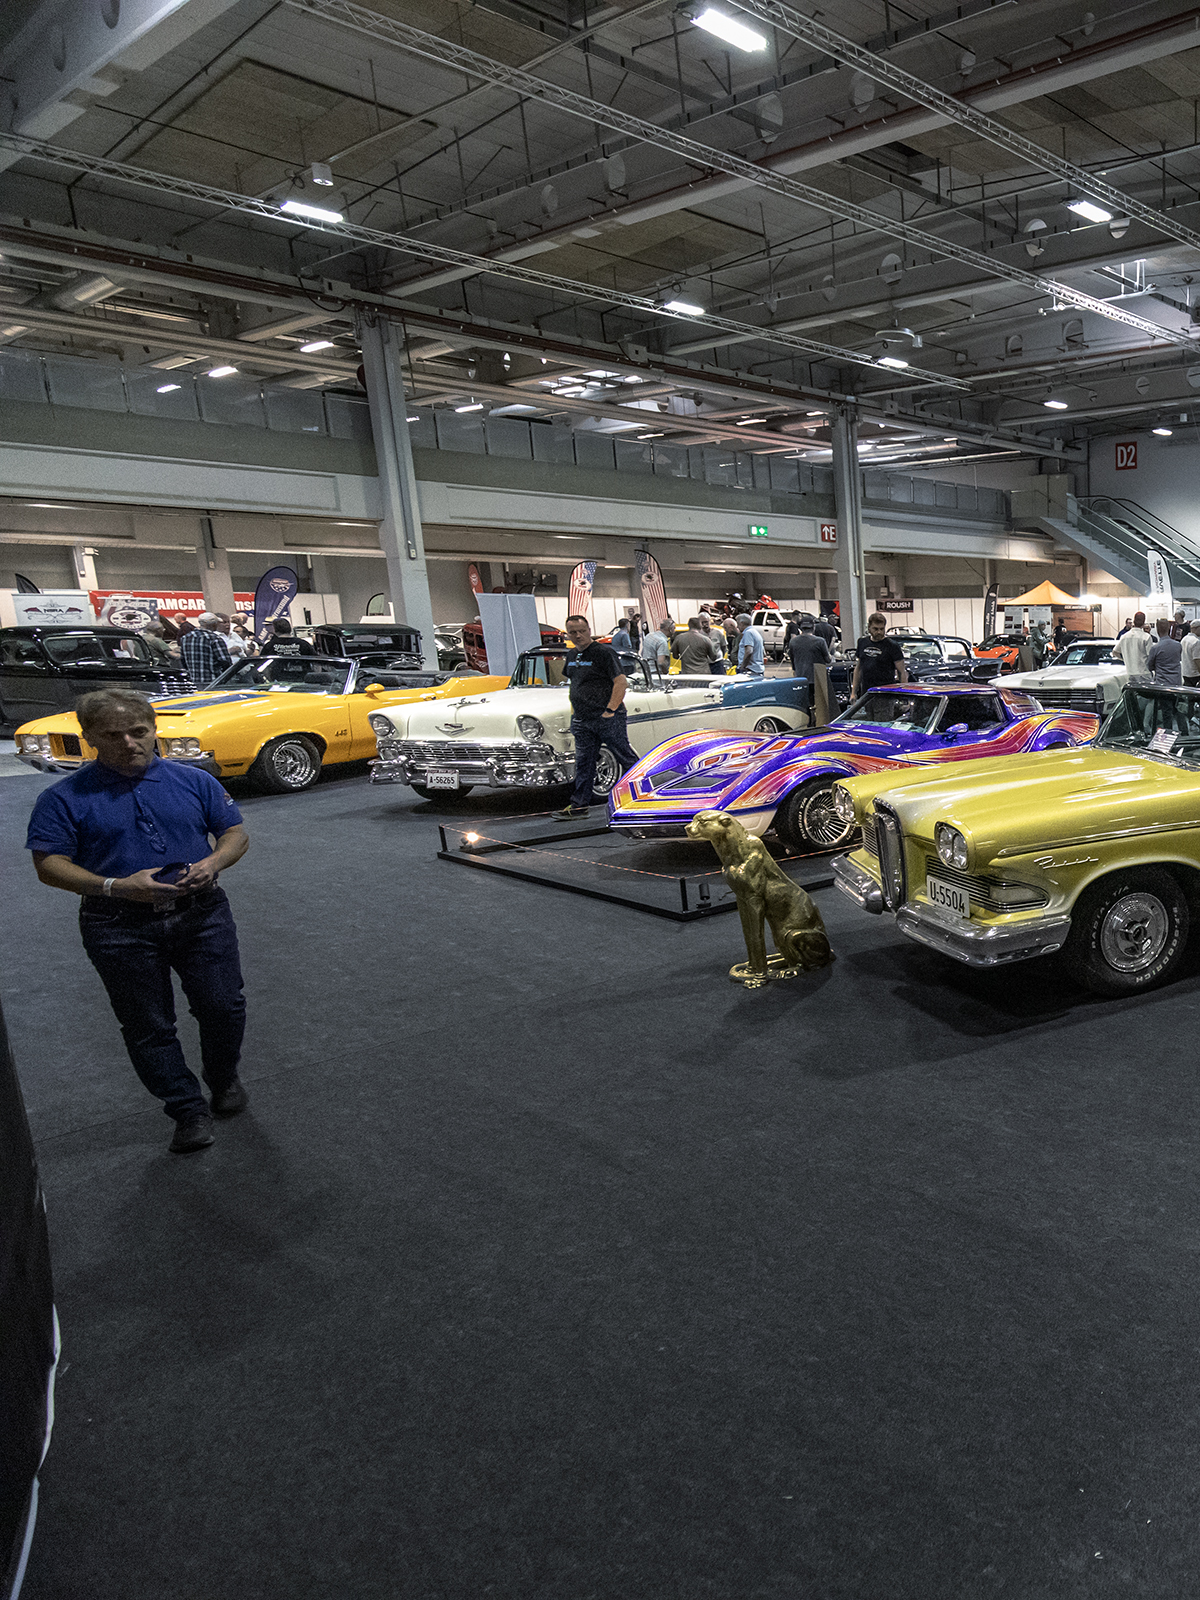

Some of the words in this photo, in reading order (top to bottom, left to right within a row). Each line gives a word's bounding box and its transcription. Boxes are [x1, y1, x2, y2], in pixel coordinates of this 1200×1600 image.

[1116, 444, 1137, 469] D2
[829, 525, 837, 541] E
[156, 598, 206, 611] AMCAR
[886, 601, 911, 609] ROUSH
[429, 776, 455, 785] A-56265
